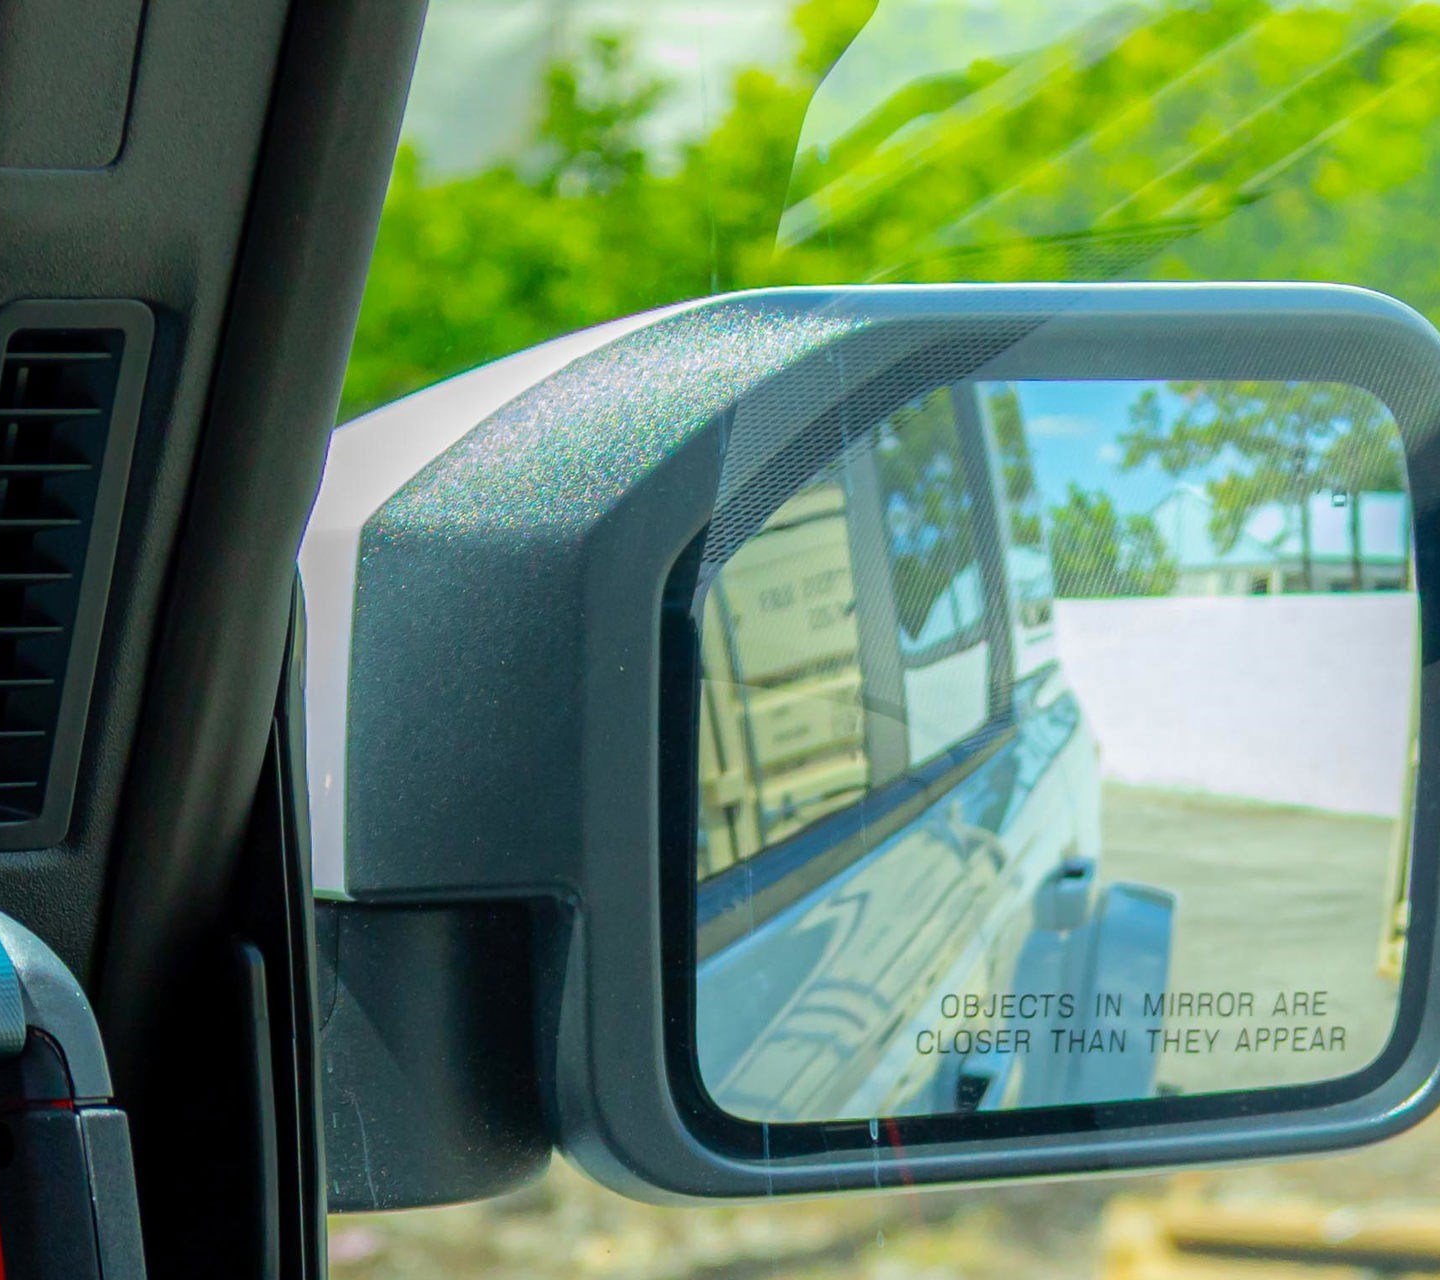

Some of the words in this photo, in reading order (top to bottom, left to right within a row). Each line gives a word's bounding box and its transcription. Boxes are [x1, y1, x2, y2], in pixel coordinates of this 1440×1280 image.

[940, 992, 1075, 1020] OBJECTS
[1094, 992, 1122, 1018] IN
[1142, 991, 1255, 1018] MIRROR
[1271, 990, 1329, 1017] ARE
[916, 1029, 1031, 1056] CLOSER
[1050, 1028, 1127, 1054] THAN
[1145, 1027, 1220, 1053] THEY
[1234, 1025, 1347, 1052] APPEAR
